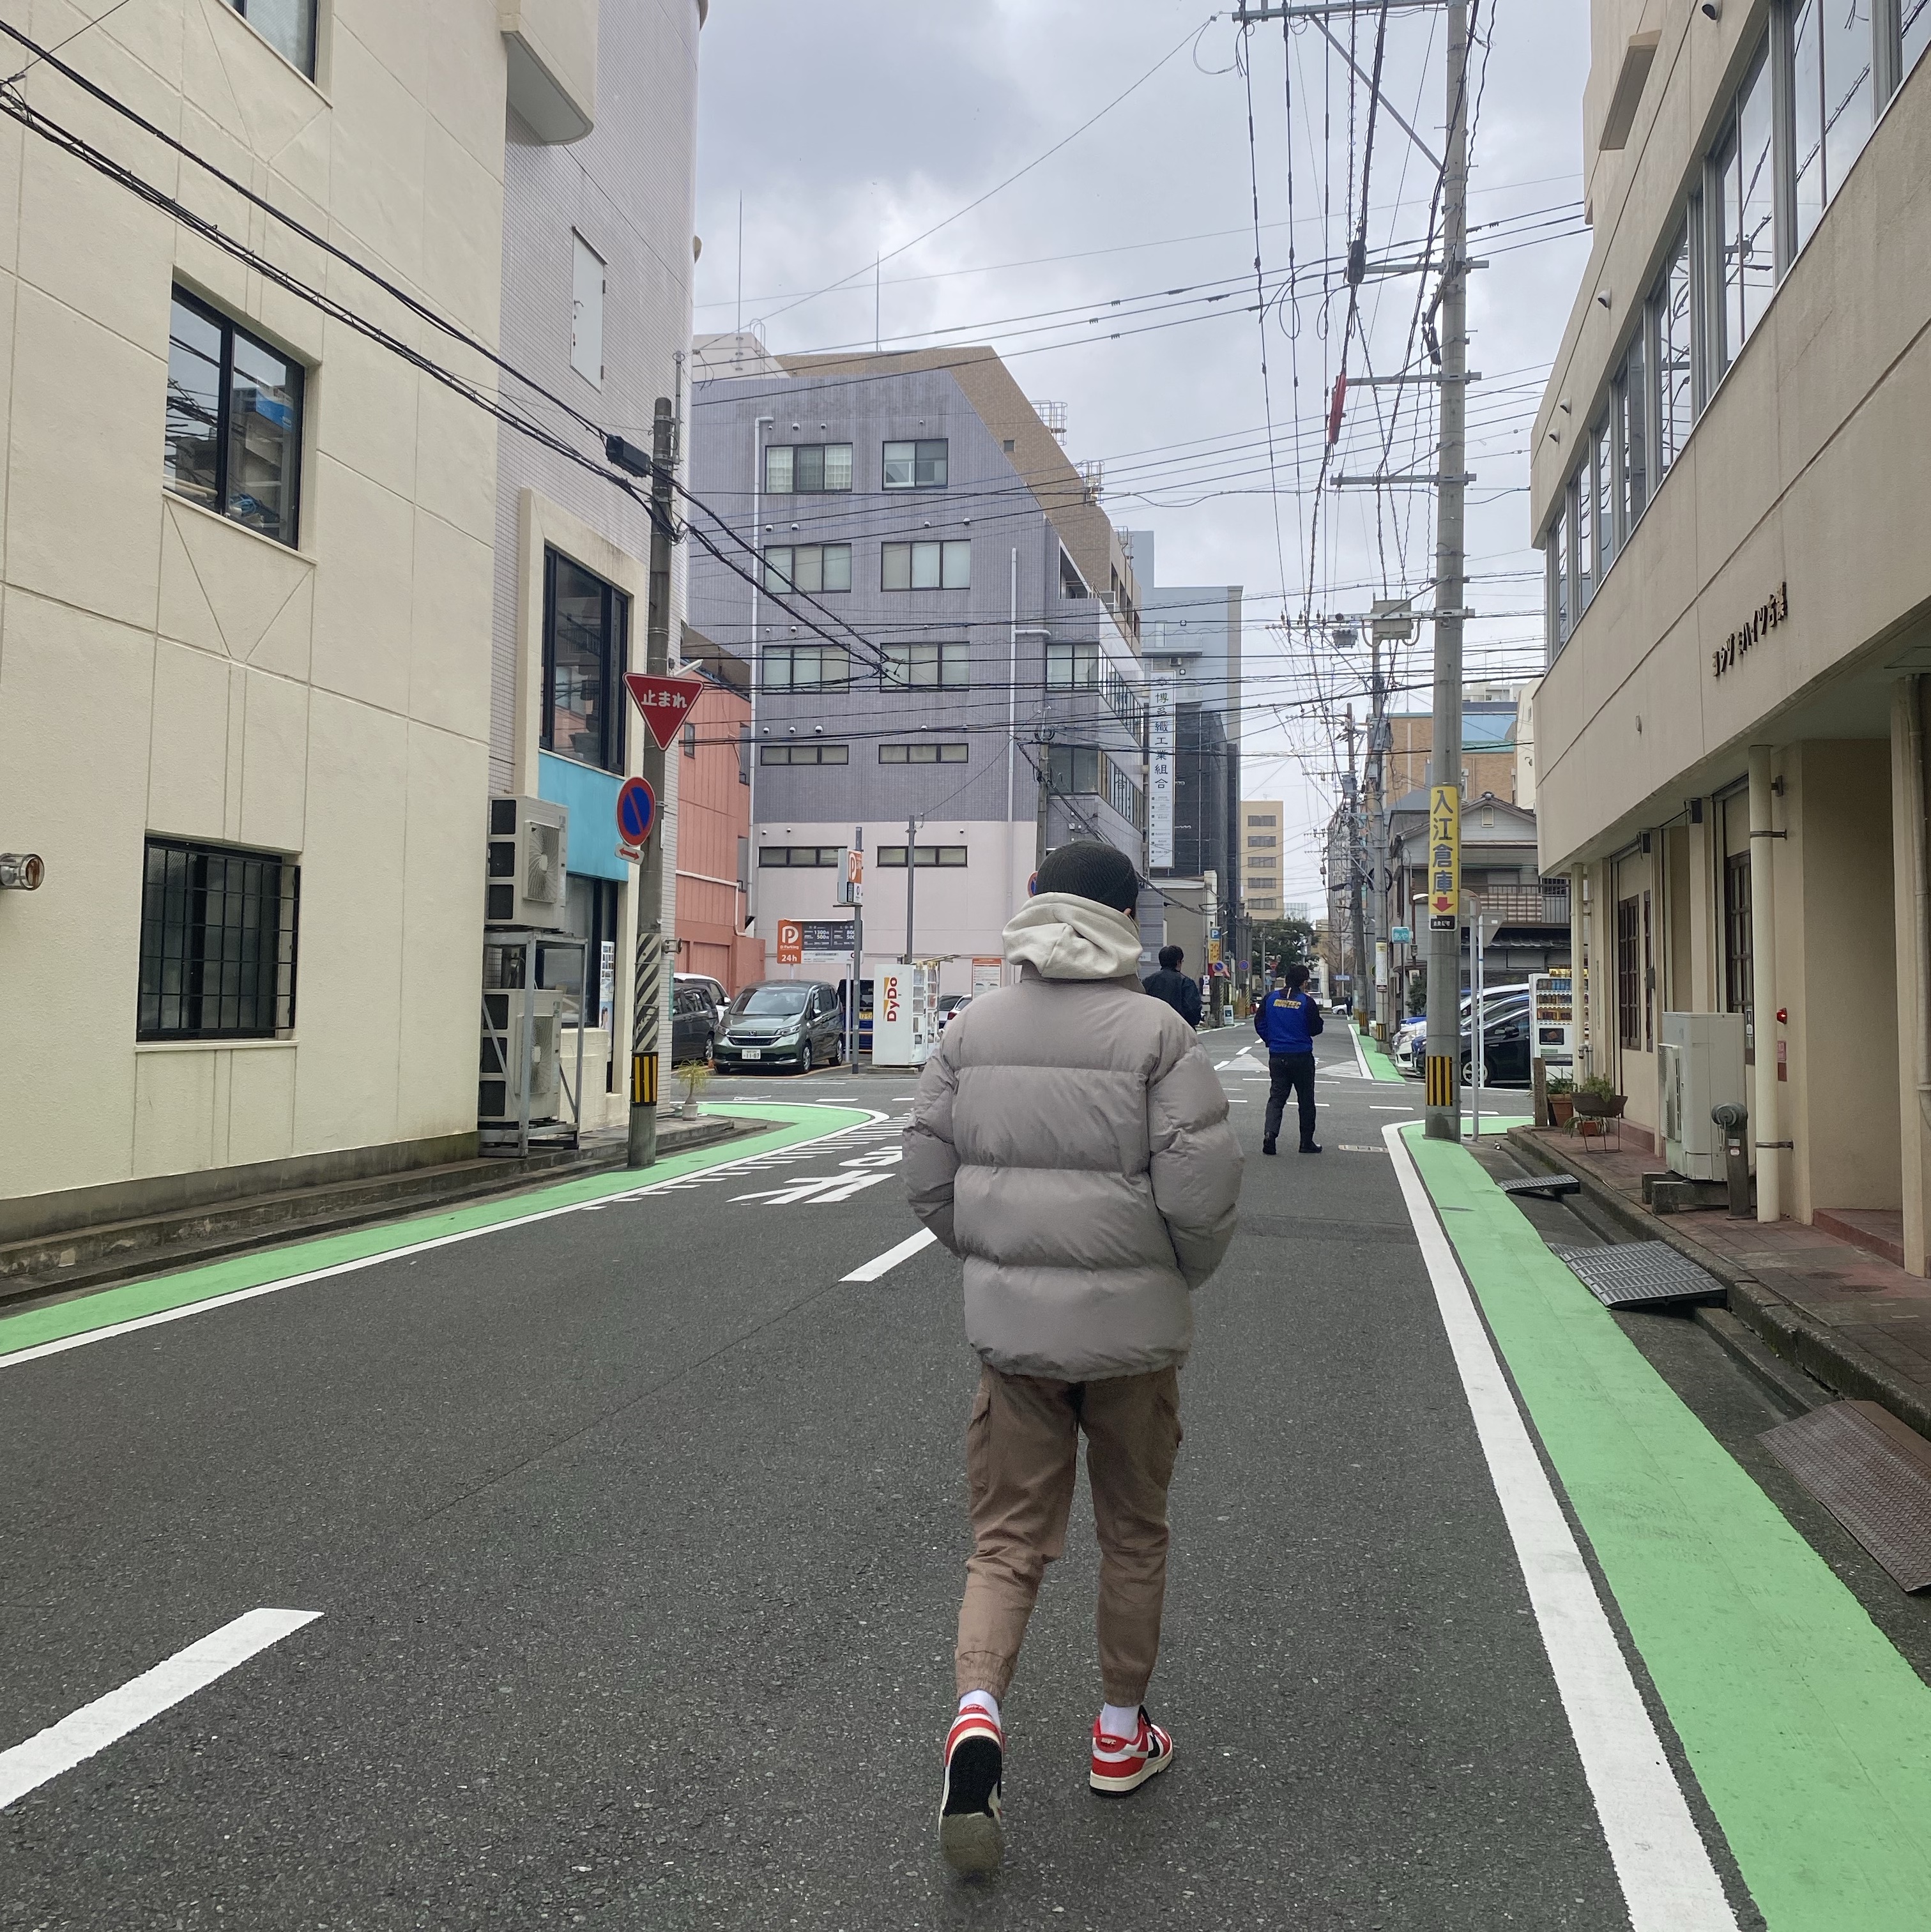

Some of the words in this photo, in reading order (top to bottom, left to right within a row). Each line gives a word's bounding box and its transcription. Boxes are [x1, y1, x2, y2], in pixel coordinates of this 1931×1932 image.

[641, 689, 688, 708] 止まれ
[1154, 692, 1170, 789] 博多織工業組合
[1433, 789, 1454, 895] 入江倉庫
[1211, 929, 1219, 938] P
[887, 977, 900, 1022] DyDo
